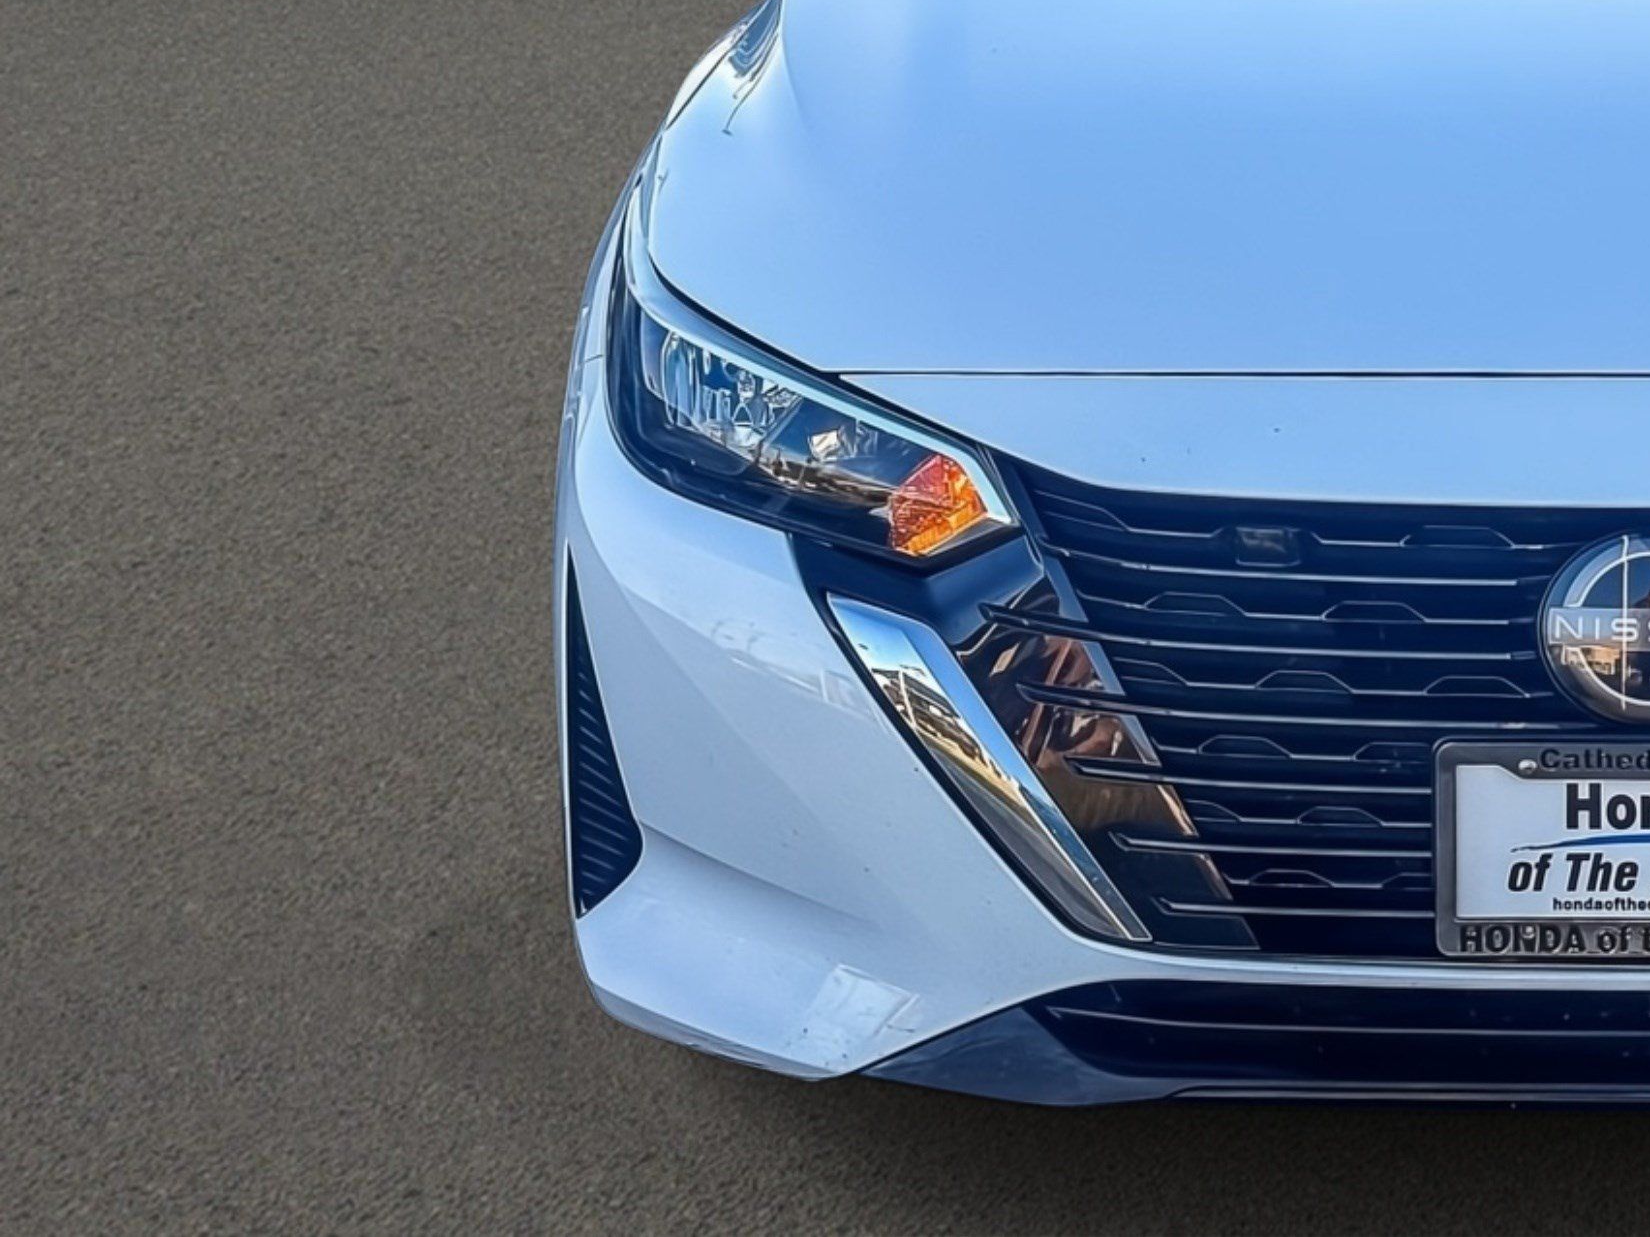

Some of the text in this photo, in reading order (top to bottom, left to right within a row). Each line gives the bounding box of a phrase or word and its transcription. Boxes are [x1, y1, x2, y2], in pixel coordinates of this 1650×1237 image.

[1508, 853, 1551, 892] of
[1565, 853, 1638, 892] The
[1460, 926, 1586, 954] HONDA
[1597, 926, 1632, 954] of
